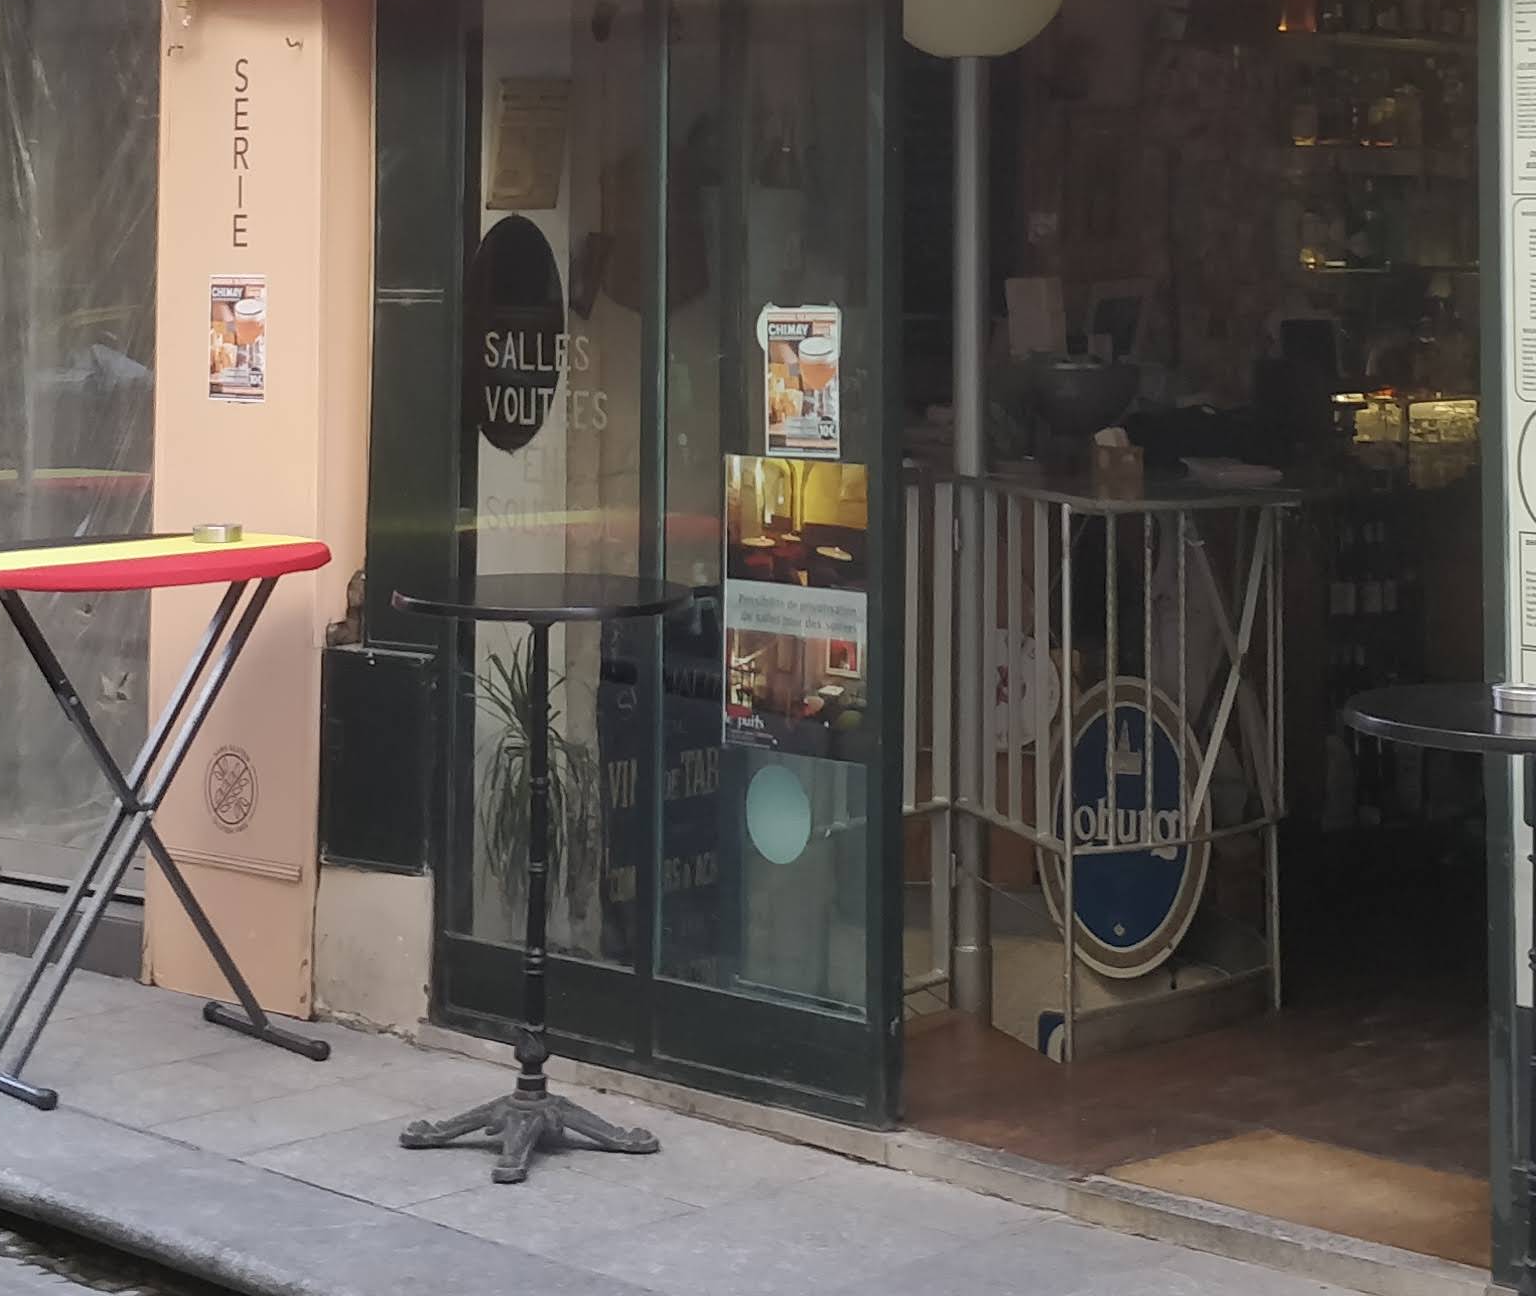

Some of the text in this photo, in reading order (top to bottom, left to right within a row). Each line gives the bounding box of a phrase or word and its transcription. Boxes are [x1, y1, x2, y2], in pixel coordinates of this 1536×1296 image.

[212, 286, 244, 297] CHIMAY
[767, 323, 810, 337] CHIMAY
[483, 330, 591, 372] SALLES
